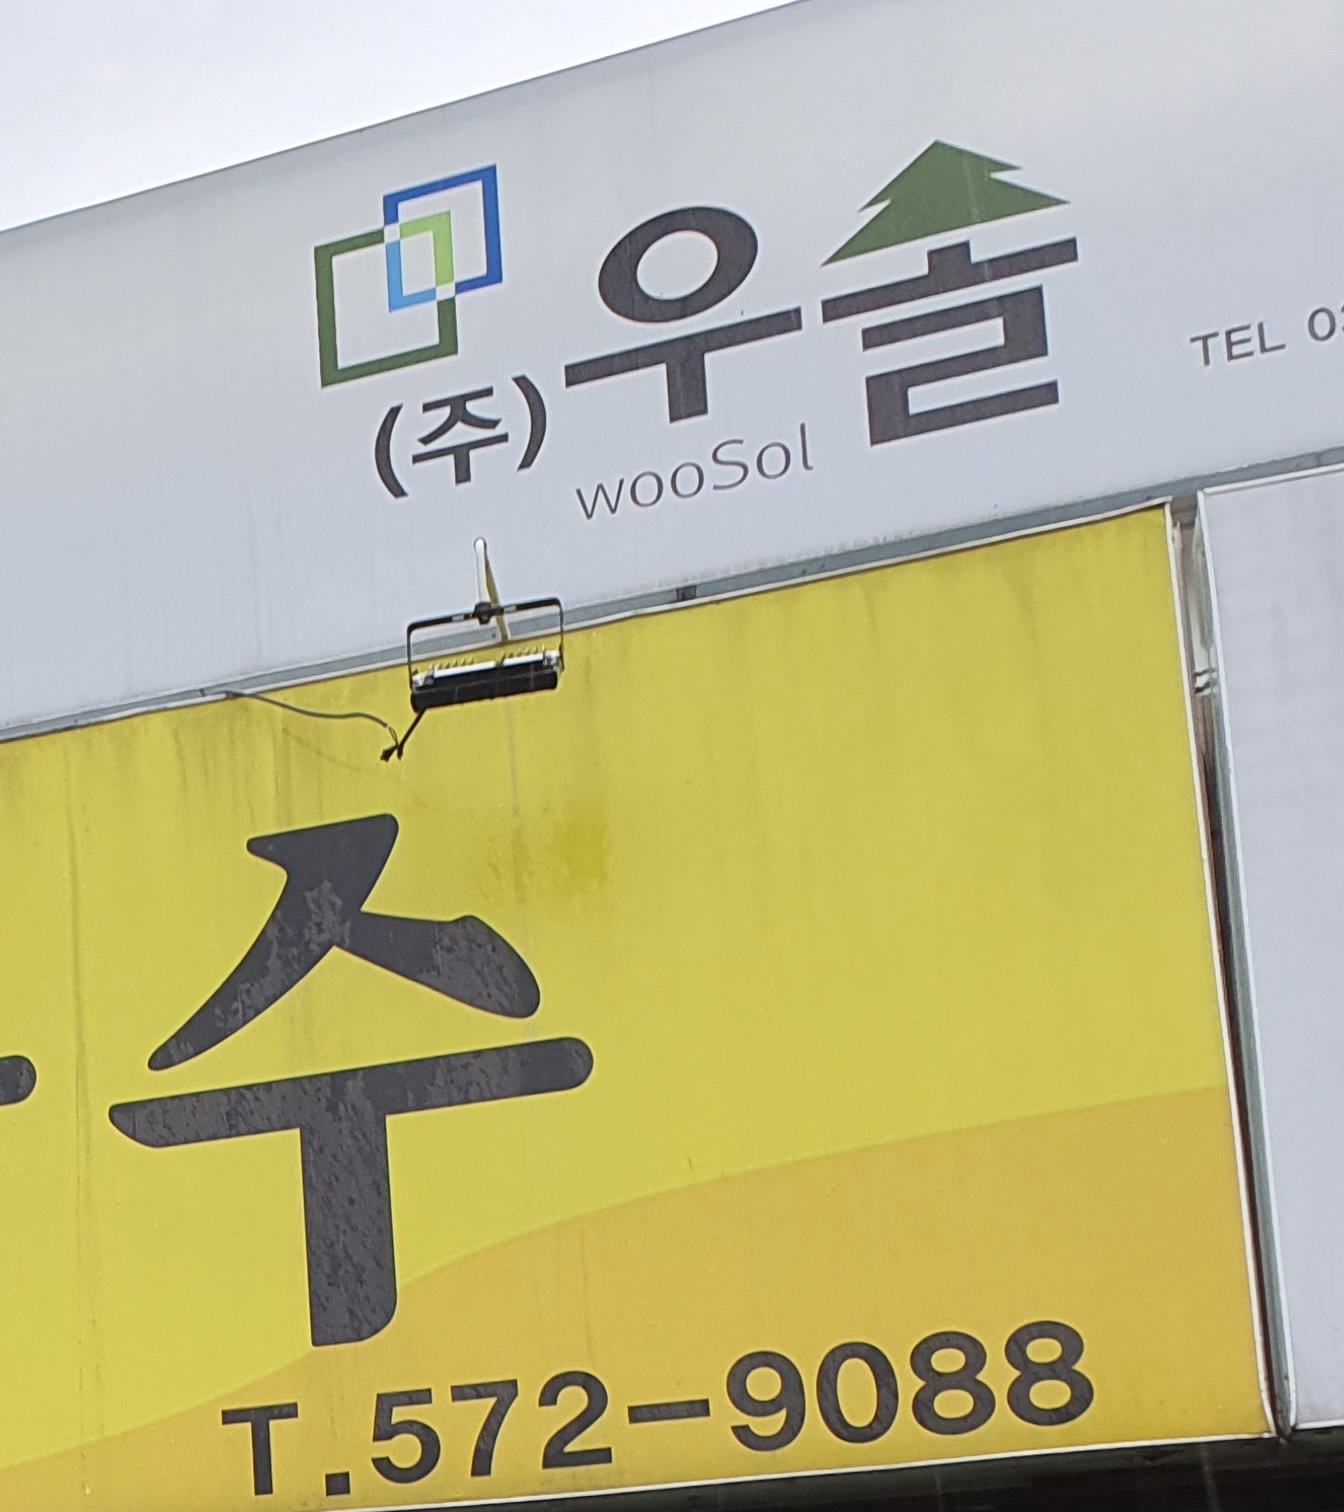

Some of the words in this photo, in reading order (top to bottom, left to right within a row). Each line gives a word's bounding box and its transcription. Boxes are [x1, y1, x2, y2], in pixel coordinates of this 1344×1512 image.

[374, 373, 548, 498] (주)
[564, 139, 1079, 447] 우솔
[1189, 320, 1287, 367] TEL
[1307, 305, 1344, 342] 0
[575, 421, 815, 521] wooSol
[220, 1319, 1095, 1497] T.572-9088
